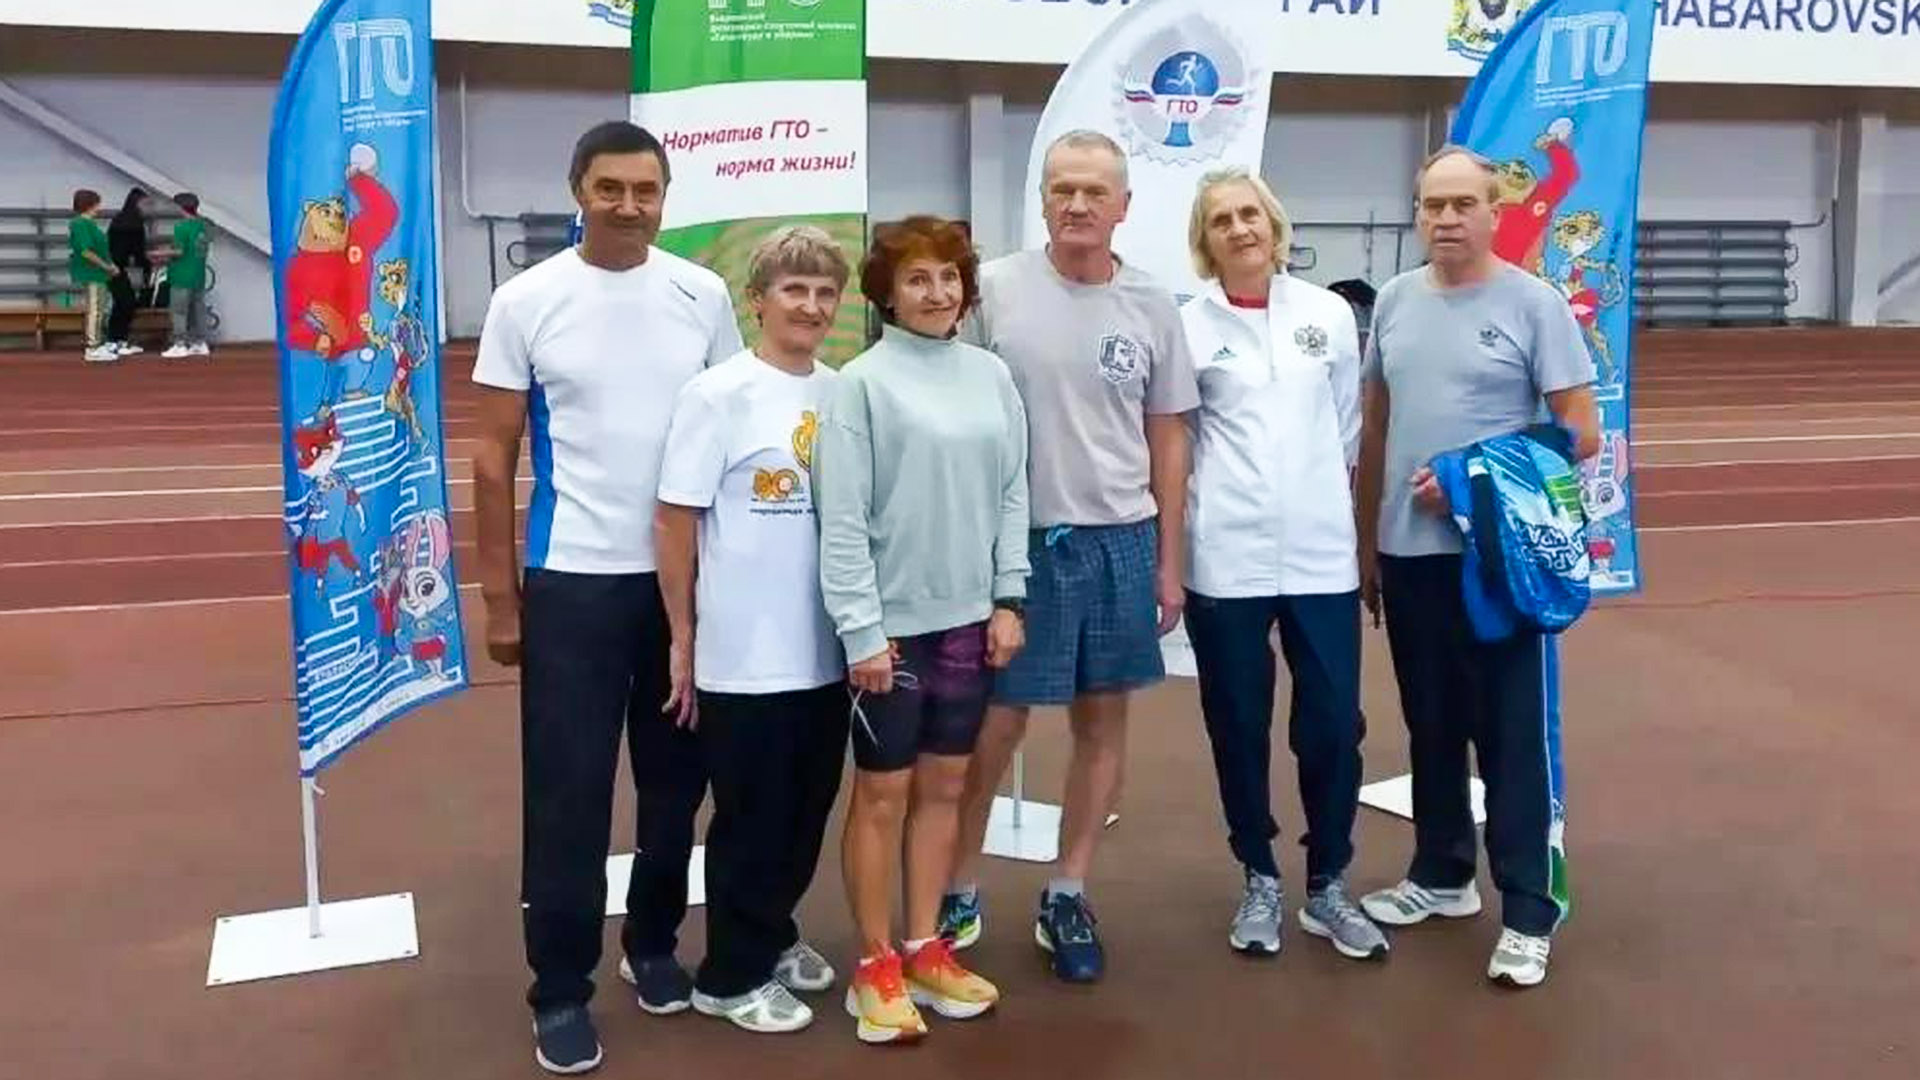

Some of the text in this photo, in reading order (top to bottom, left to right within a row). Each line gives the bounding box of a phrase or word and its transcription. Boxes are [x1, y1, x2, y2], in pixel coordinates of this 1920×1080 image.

[334, 18, 414, 103] ГТО
[1535, 11, 1628, 84] ГТО
[1166, 99, 1198, 115] ГТО
[662, 126, 763, 151] Норматив
[770, 120, 810, 139] ГТО
[716, 151, 857, 179] норма жизни!
